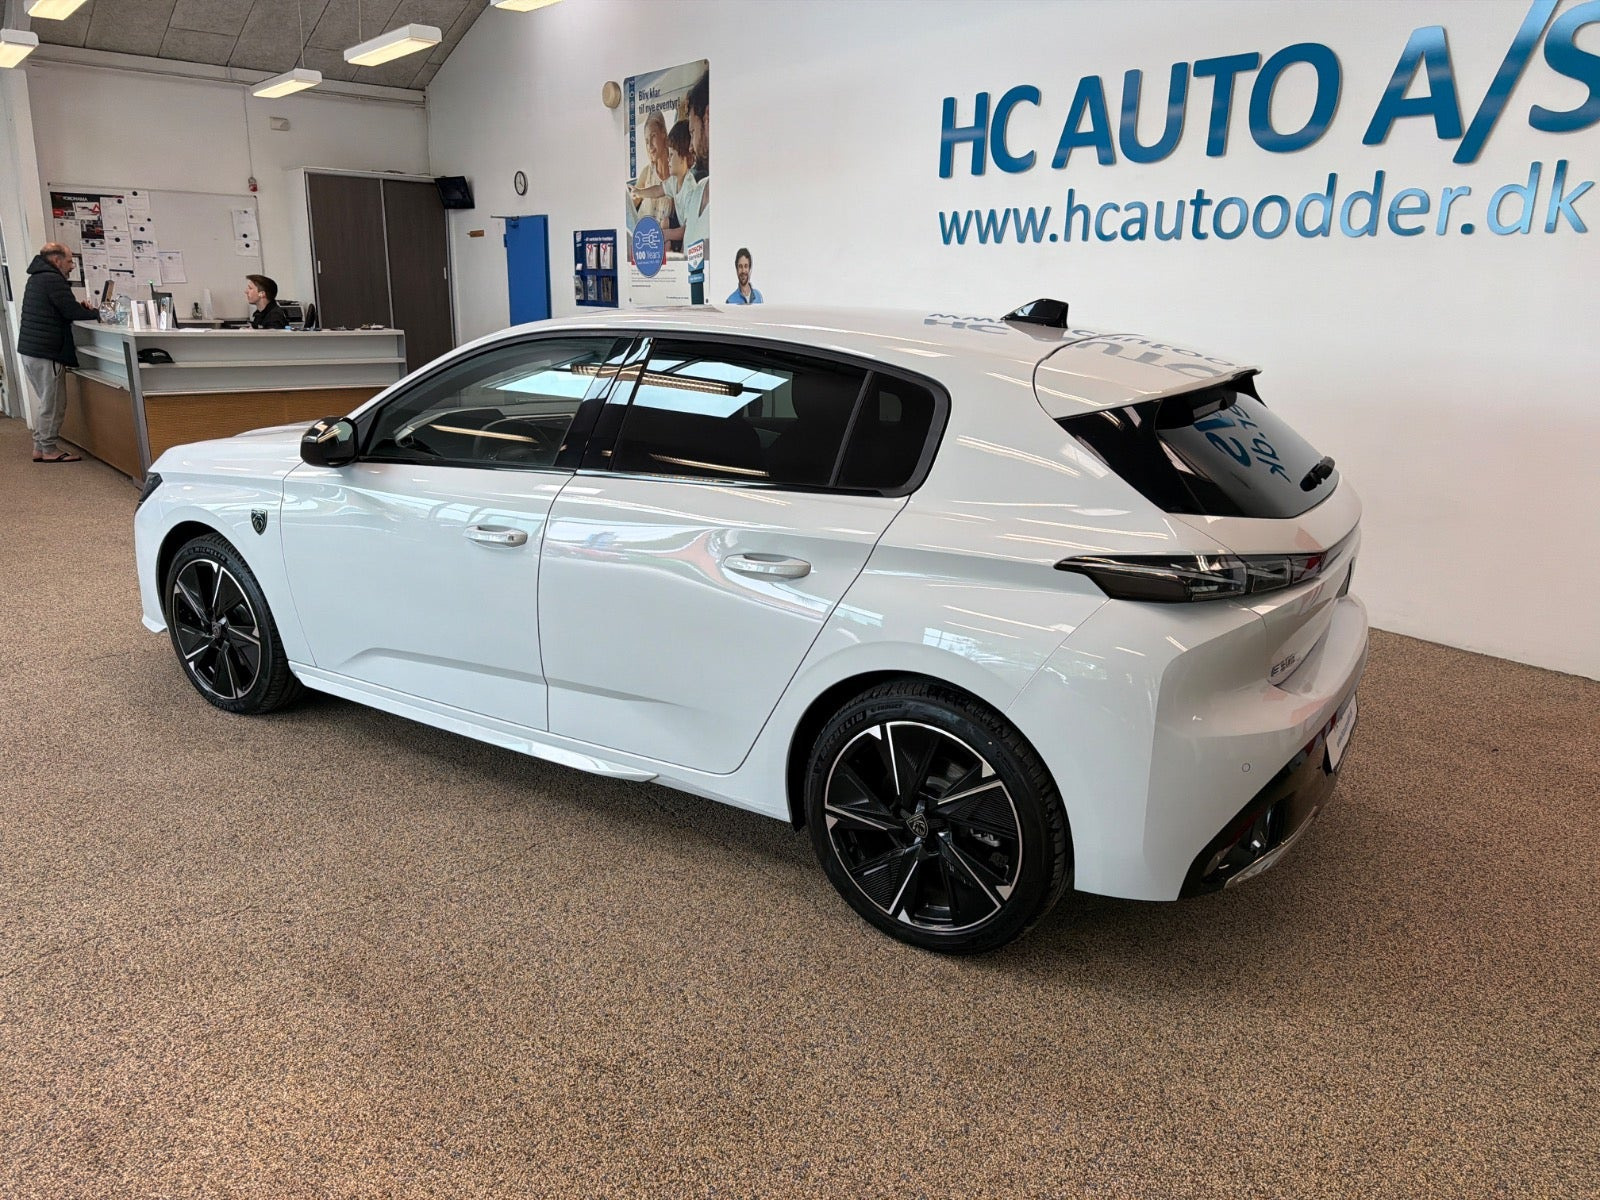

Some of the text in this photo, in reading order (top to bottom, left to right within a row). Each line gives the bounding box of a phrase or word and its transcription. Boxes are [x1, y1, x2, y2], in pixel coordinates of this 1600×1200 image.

[649, 87, 661, 99] klar
[939, 0, 1600, 179] HC AUTO A/S
[645, 103, 655, 114] nye
[938, 160, 1595, 246] www.hcautoodder.dk
[635, 250, 661, 260] 100 Years
